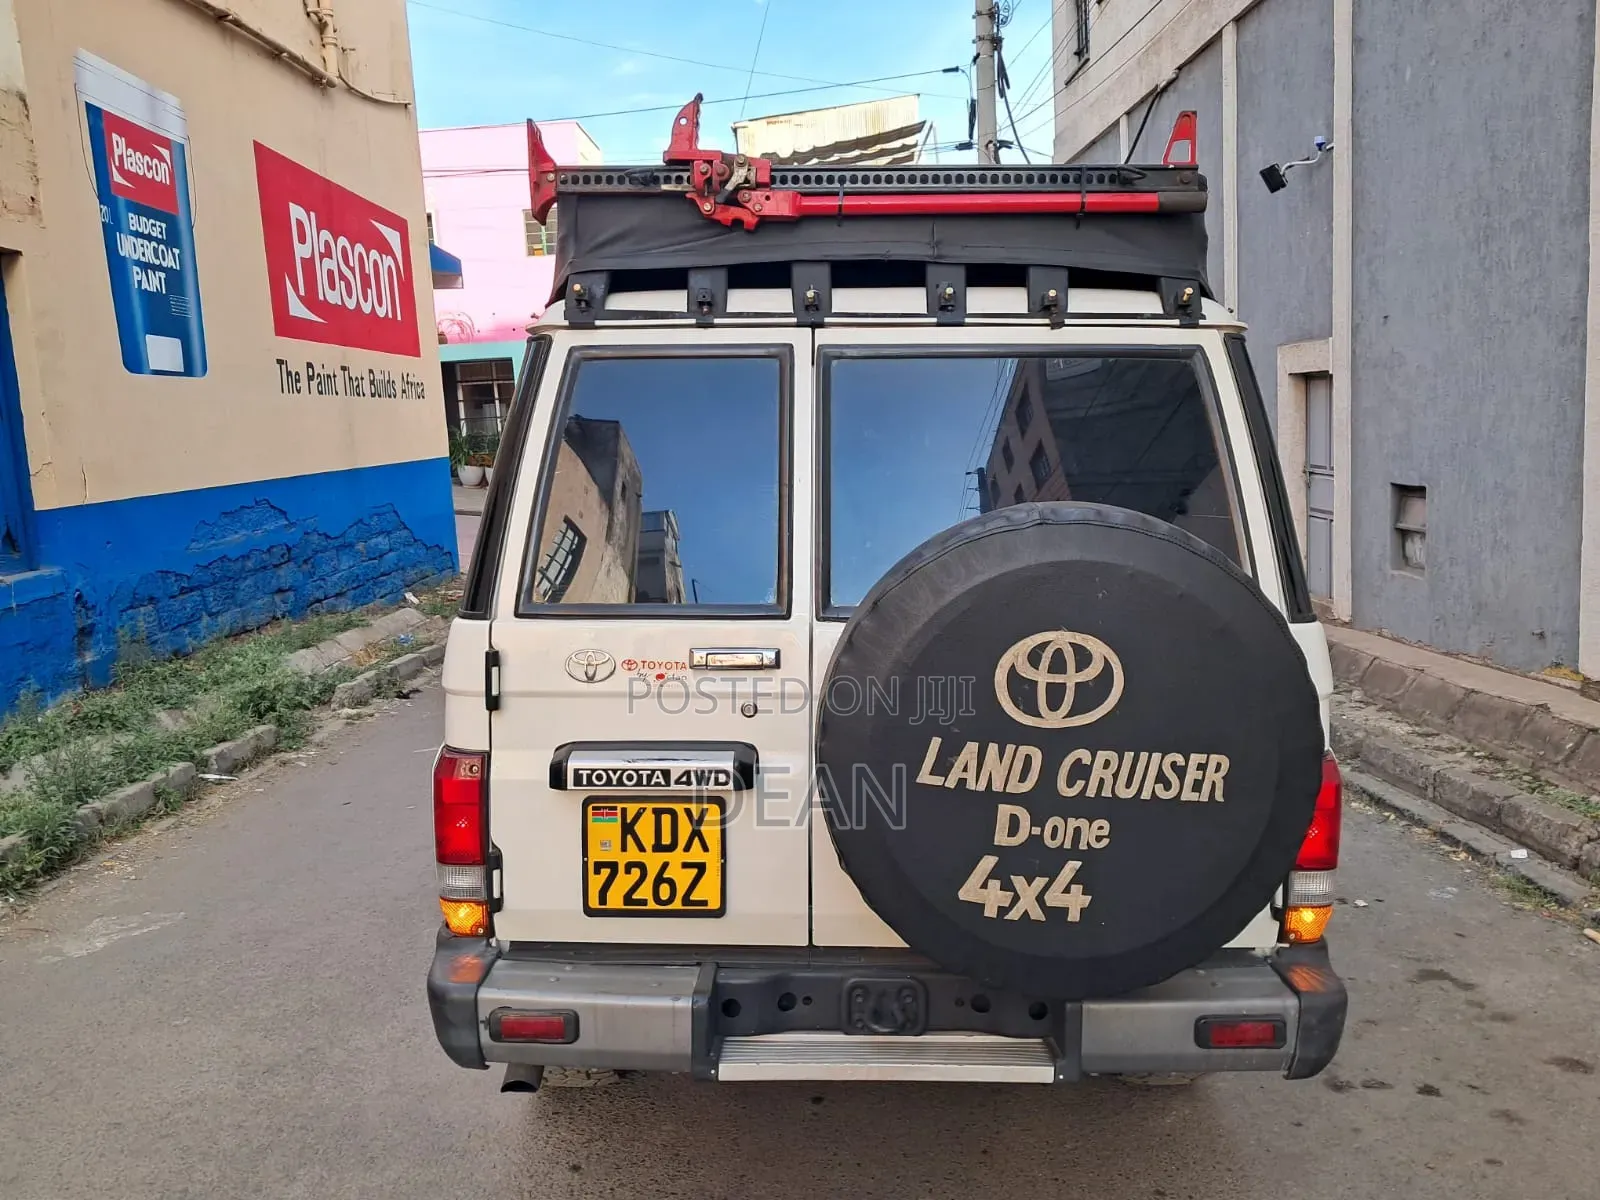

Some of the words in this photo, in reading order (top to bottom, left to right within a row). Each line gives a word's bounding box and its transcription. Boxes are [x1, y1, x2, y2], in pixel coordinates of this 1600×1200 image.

[112, 132, 170, 186] Plascon
[128, 212, 167, 240] BUDGET
[116, 231, 180, 271] UNDERCOAT
[289, 201, 402, 321] Plascon
[133, 265, 167, 294] PAINT
[276, 358, 301, 394] The
[306, 361, 339, 396] Paint
[340, 365, 365, 397] That
[368, 368, 397, 399] Builds
[401, 371, 425, 400] Africa
[640, 660, 687, 671] TOYOTA
[578, 769, 666, 786] TOYOTA
[673, 769, 731, 787] 4WD
[915, 736, 1043, 794] LAND
[1056, 748, 1231, 803] CRUISER
[620, 806, 710, 853] KDX
[993, 803, 1112, 850] D-one
[593, 860, 709, 907] 726Z
[957, 854, 1093, 922] 4x4
